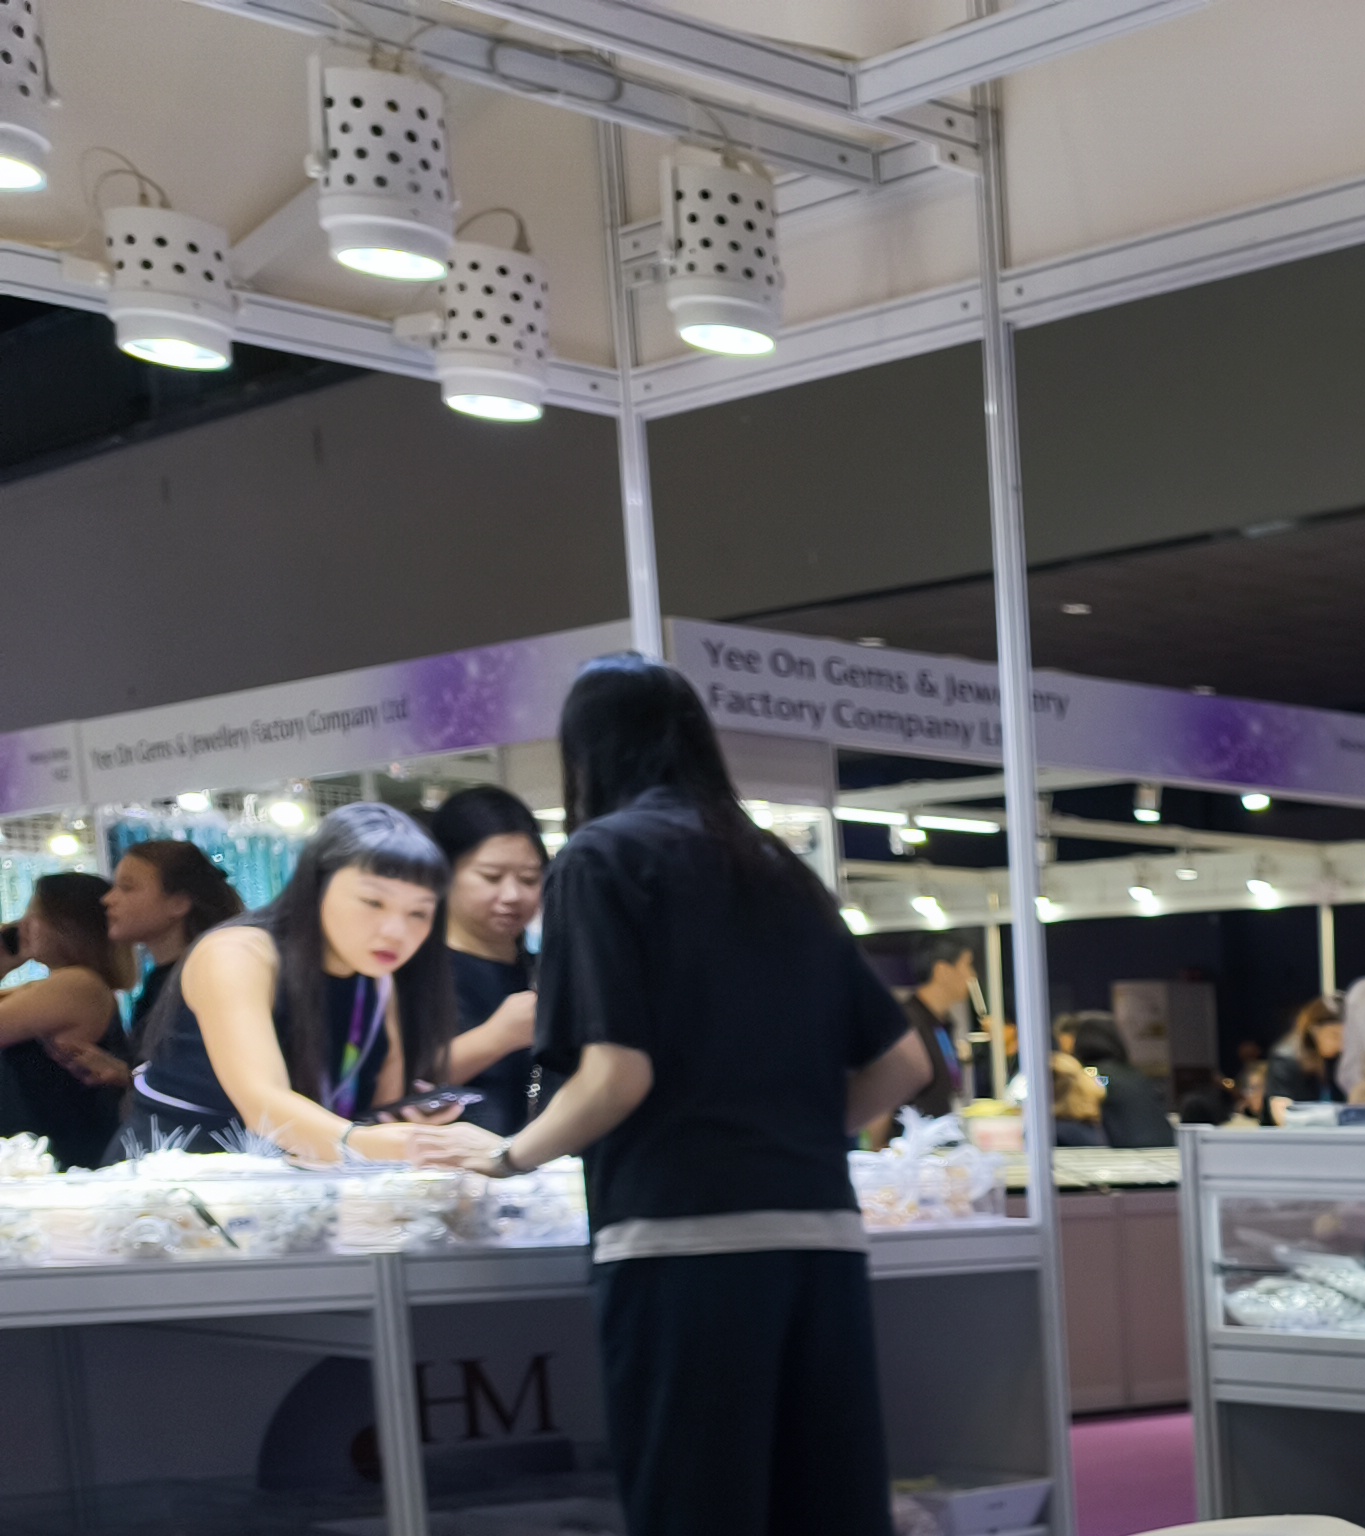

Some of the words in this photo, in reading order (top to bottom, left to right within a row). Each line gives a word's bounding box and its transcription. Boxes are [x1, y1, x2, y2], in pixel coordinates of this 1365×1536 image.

[703, 639, 761, 674] Yee
[768, 648, 815, 682] On
[823, 656, 908, 695] Gems
[914, 670, 938, 698] &
[306, 705, 377, 737] Company
[708, 684, 826, 729] Factory
[832, 698, 973, 748] Company
